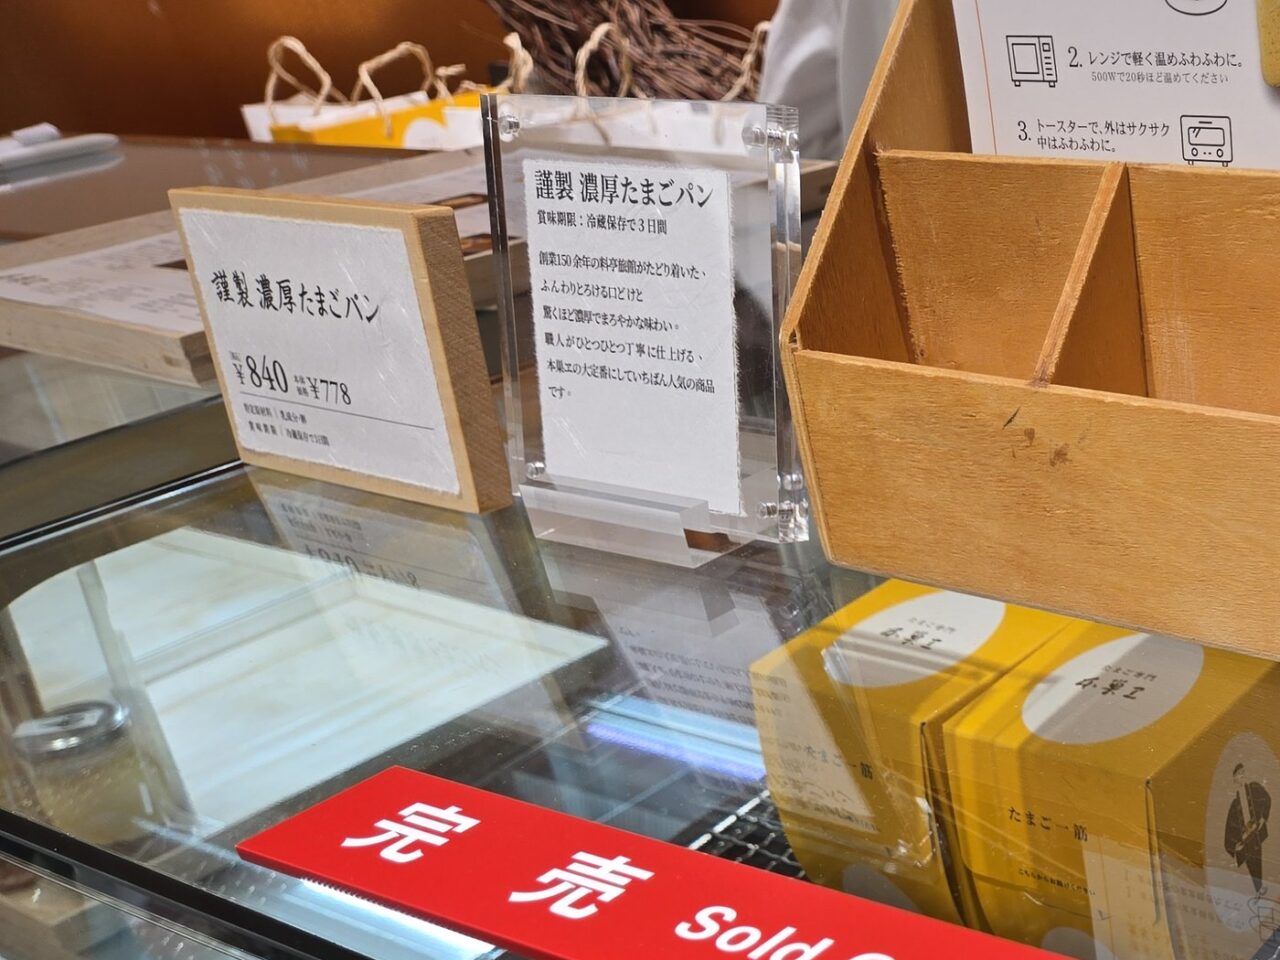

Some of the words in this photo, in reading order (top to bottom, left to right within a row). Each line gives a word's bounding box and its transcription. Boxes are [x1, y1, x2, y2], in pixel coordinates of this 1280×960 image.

[1068, 47, 1083, 69] 2.
[1088, 51, 1243, 70] レンジで軽く温めふわふわに。
[1091, 71, 1229, 85] 500Wで20秒ほど温めてください
[1017, 120, 1032, 142] 3.
[1036, 118, 1171, 137] トースターで、外はサクサク
[1036, 135, 1118, 153] 中はふわふわに。
[534, 170, 573, 201] 謹製
[579, 171, 714, 208] 濃厚たまごパン
[211, 271, 254, 309] 謹製
[256, 274, 380, 323] 濃厚たまごパン
[306, 376, 351, 405] ¥778
